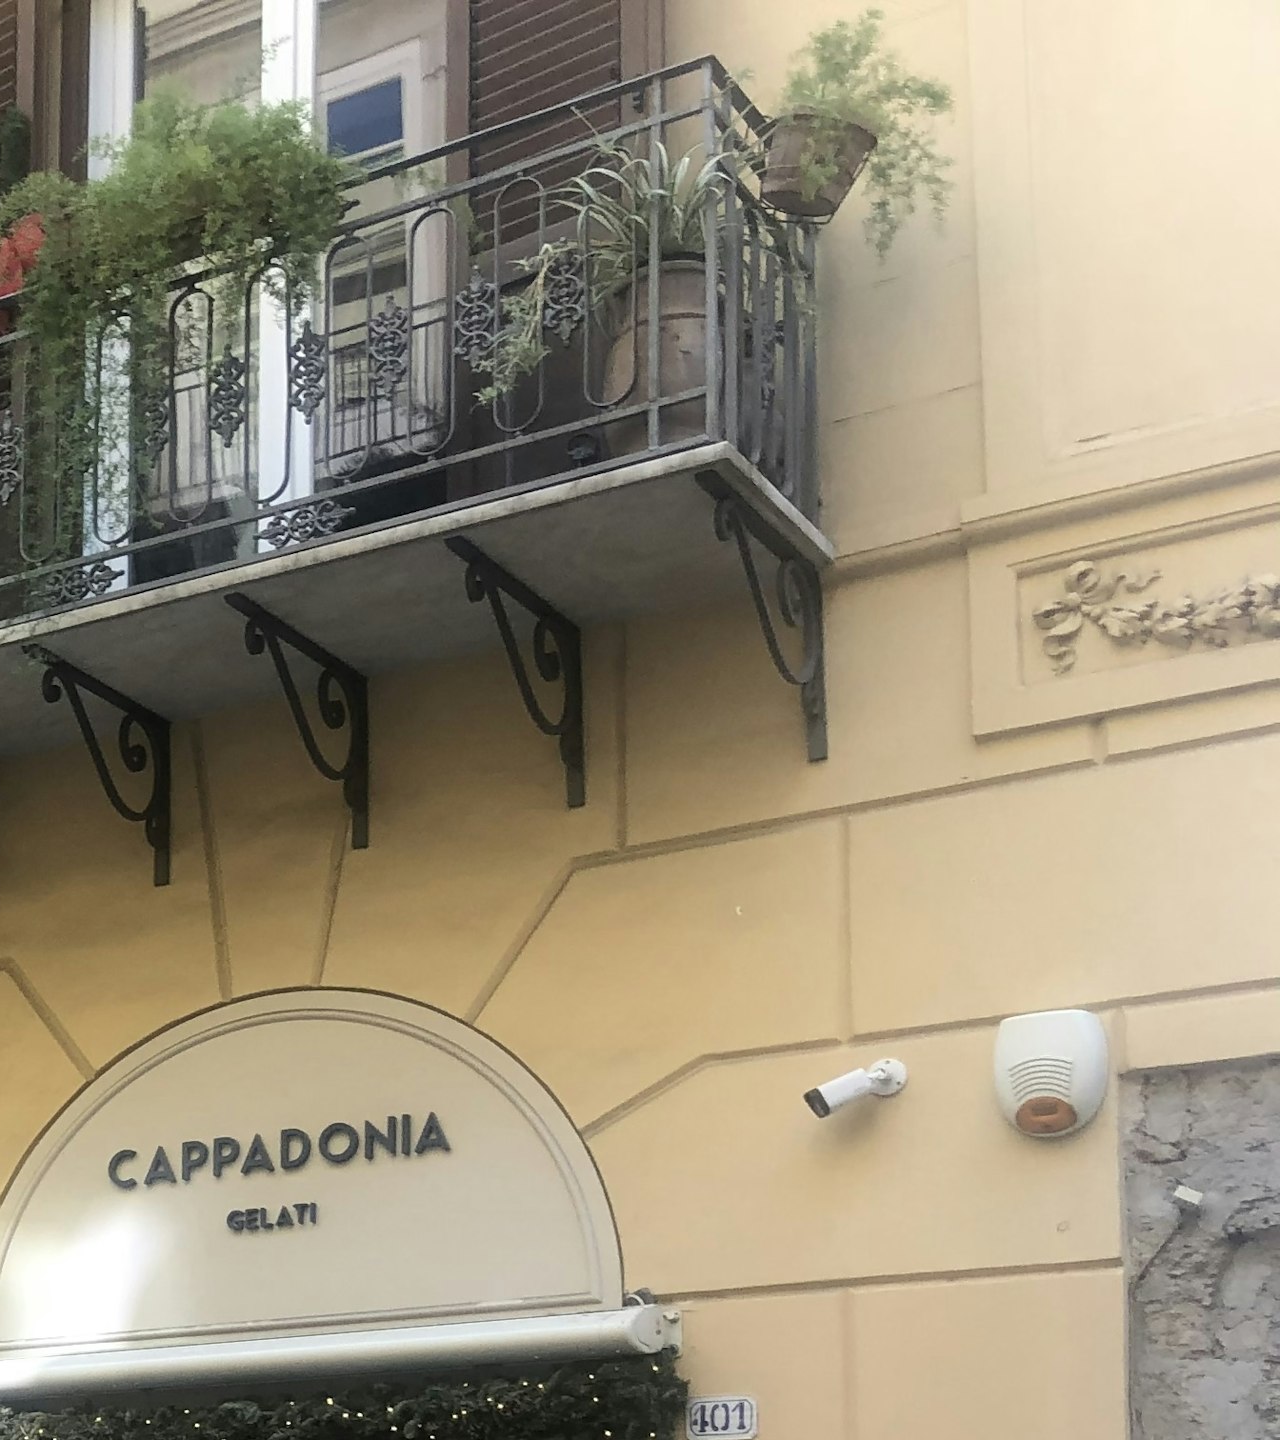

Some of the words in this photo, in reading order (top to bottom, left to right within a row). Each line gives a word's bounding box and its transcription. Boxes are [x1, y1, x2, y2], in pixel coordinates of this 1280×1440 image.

[107, 1111, 452, 1191] CAPPADONIA
[226, 1202, 318, 1233] GELATI
[692, 1401, 746, 1432] 401
